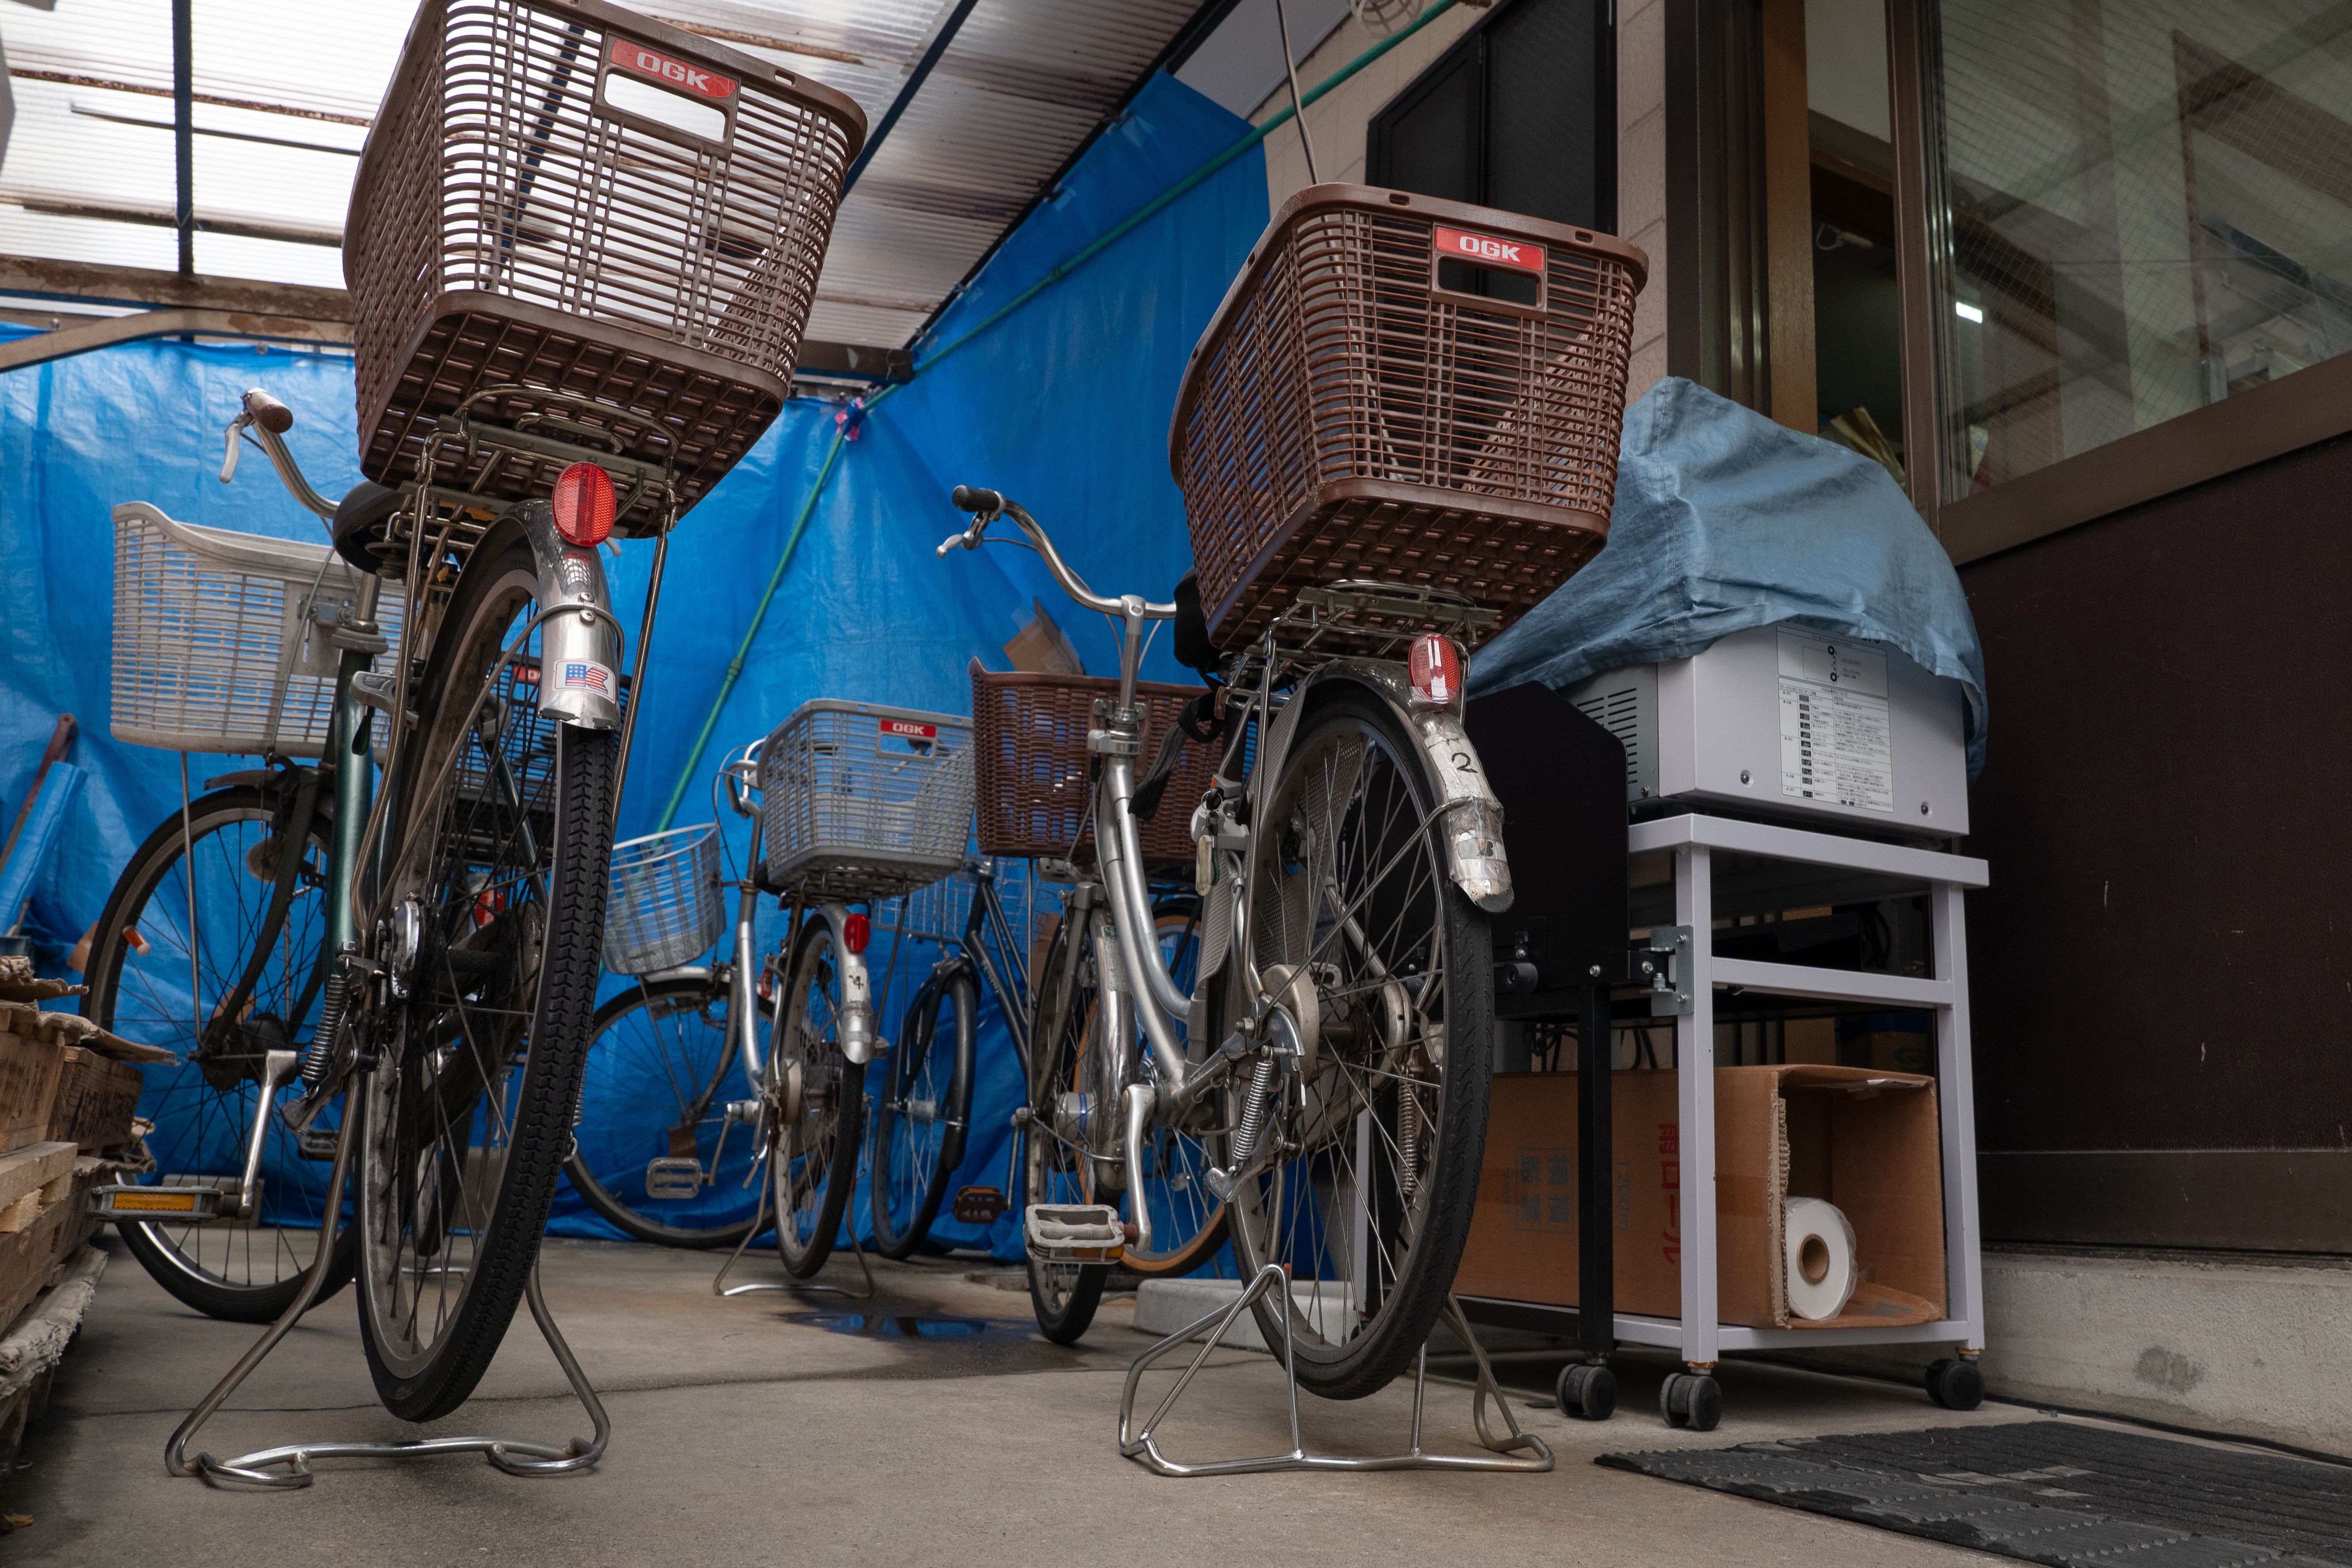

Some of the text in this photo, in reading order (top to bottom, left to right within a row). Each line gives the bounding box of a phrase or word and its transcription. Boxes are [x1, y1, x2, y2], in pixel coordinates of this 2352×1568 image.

[637, 52, 709, 92] OGK
[1460, 236, 1521, 262] OGK
[893, 722, 924, 735] OGK
[1451, 752, 1478, 773] 2
[1616, 1160, 1630, 1232] 1200m
